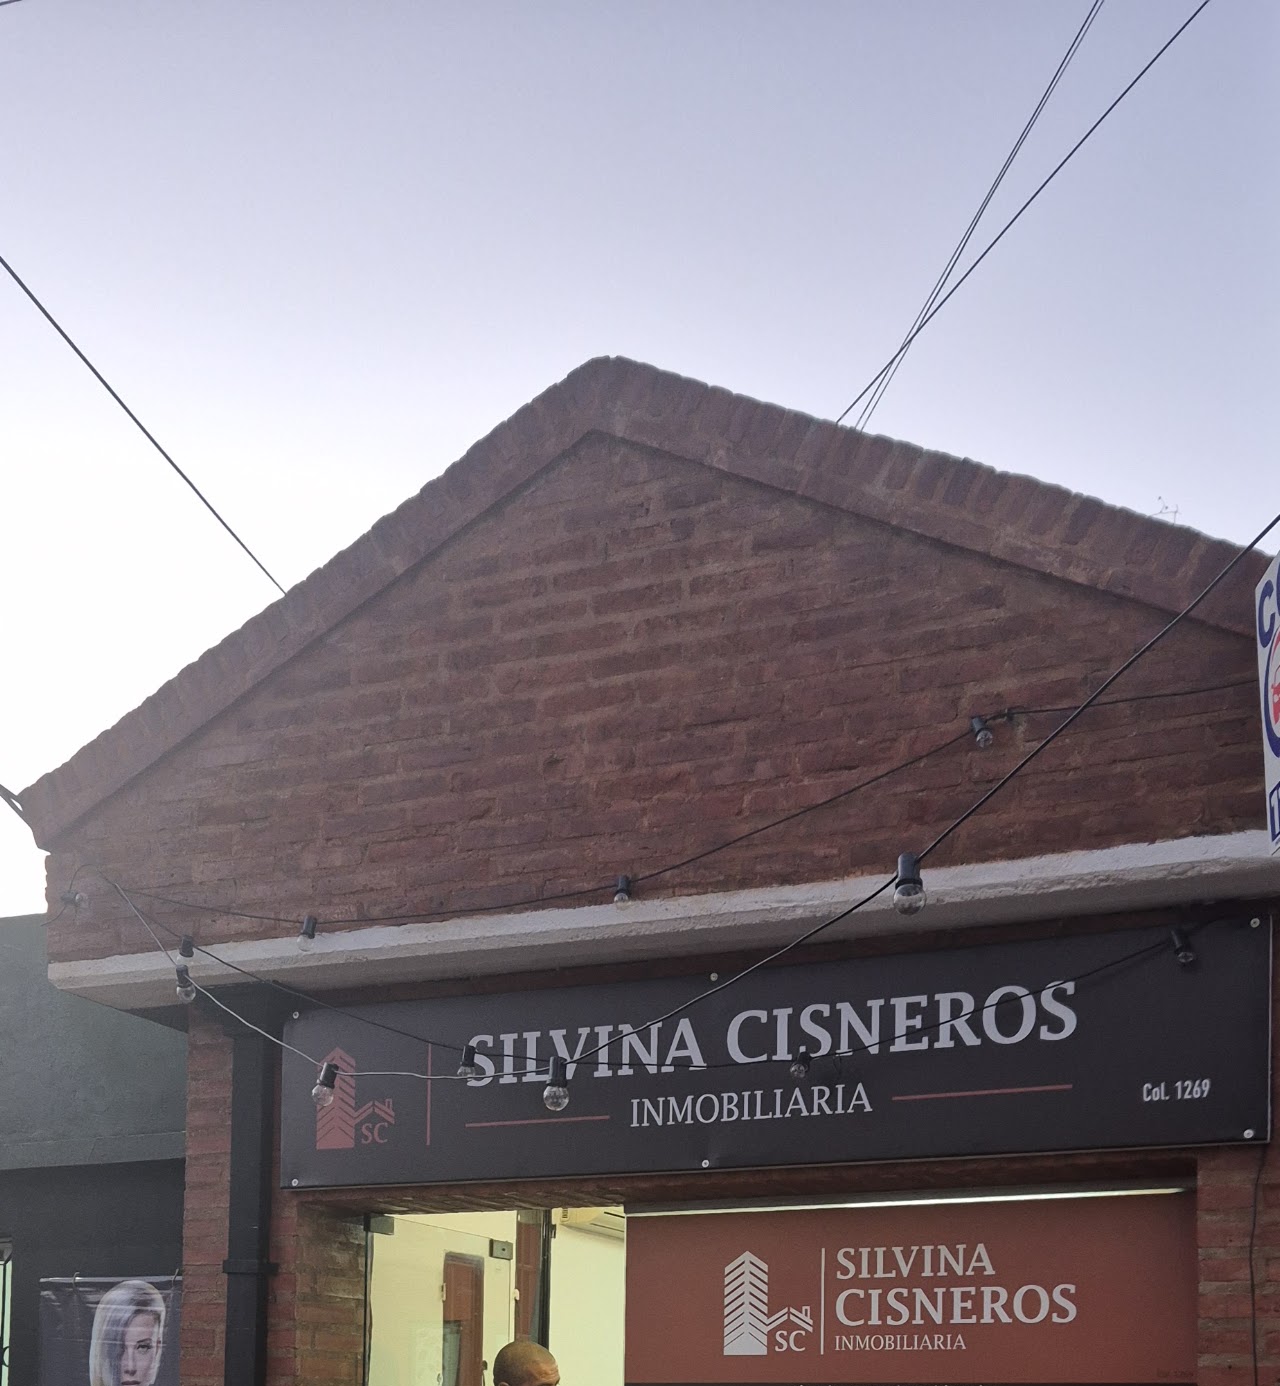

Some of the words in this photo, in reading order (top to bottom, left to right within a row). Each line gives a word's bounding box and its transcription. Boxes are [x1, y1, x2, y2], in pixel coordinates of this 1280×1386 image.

[466, 1018, 708, 1087] SILVINA
[726, 980, 1078, 1064] CISNEROS
[630, 1082, 873, 1128] INMOBILIARIA
[1142, 1081, 1170, 1102] Col.
[1174, 1078, 1211, 1100] 1269
[361, 1122, 389, 1144] SC
[836, 1243, 996, 1280] SILVINA
[835, 1283, 1078, 1327] CISNEROS
[774, 1331, 806, 1352] SC
[834, 1333, 967, 1351] INMOBILIARIA
